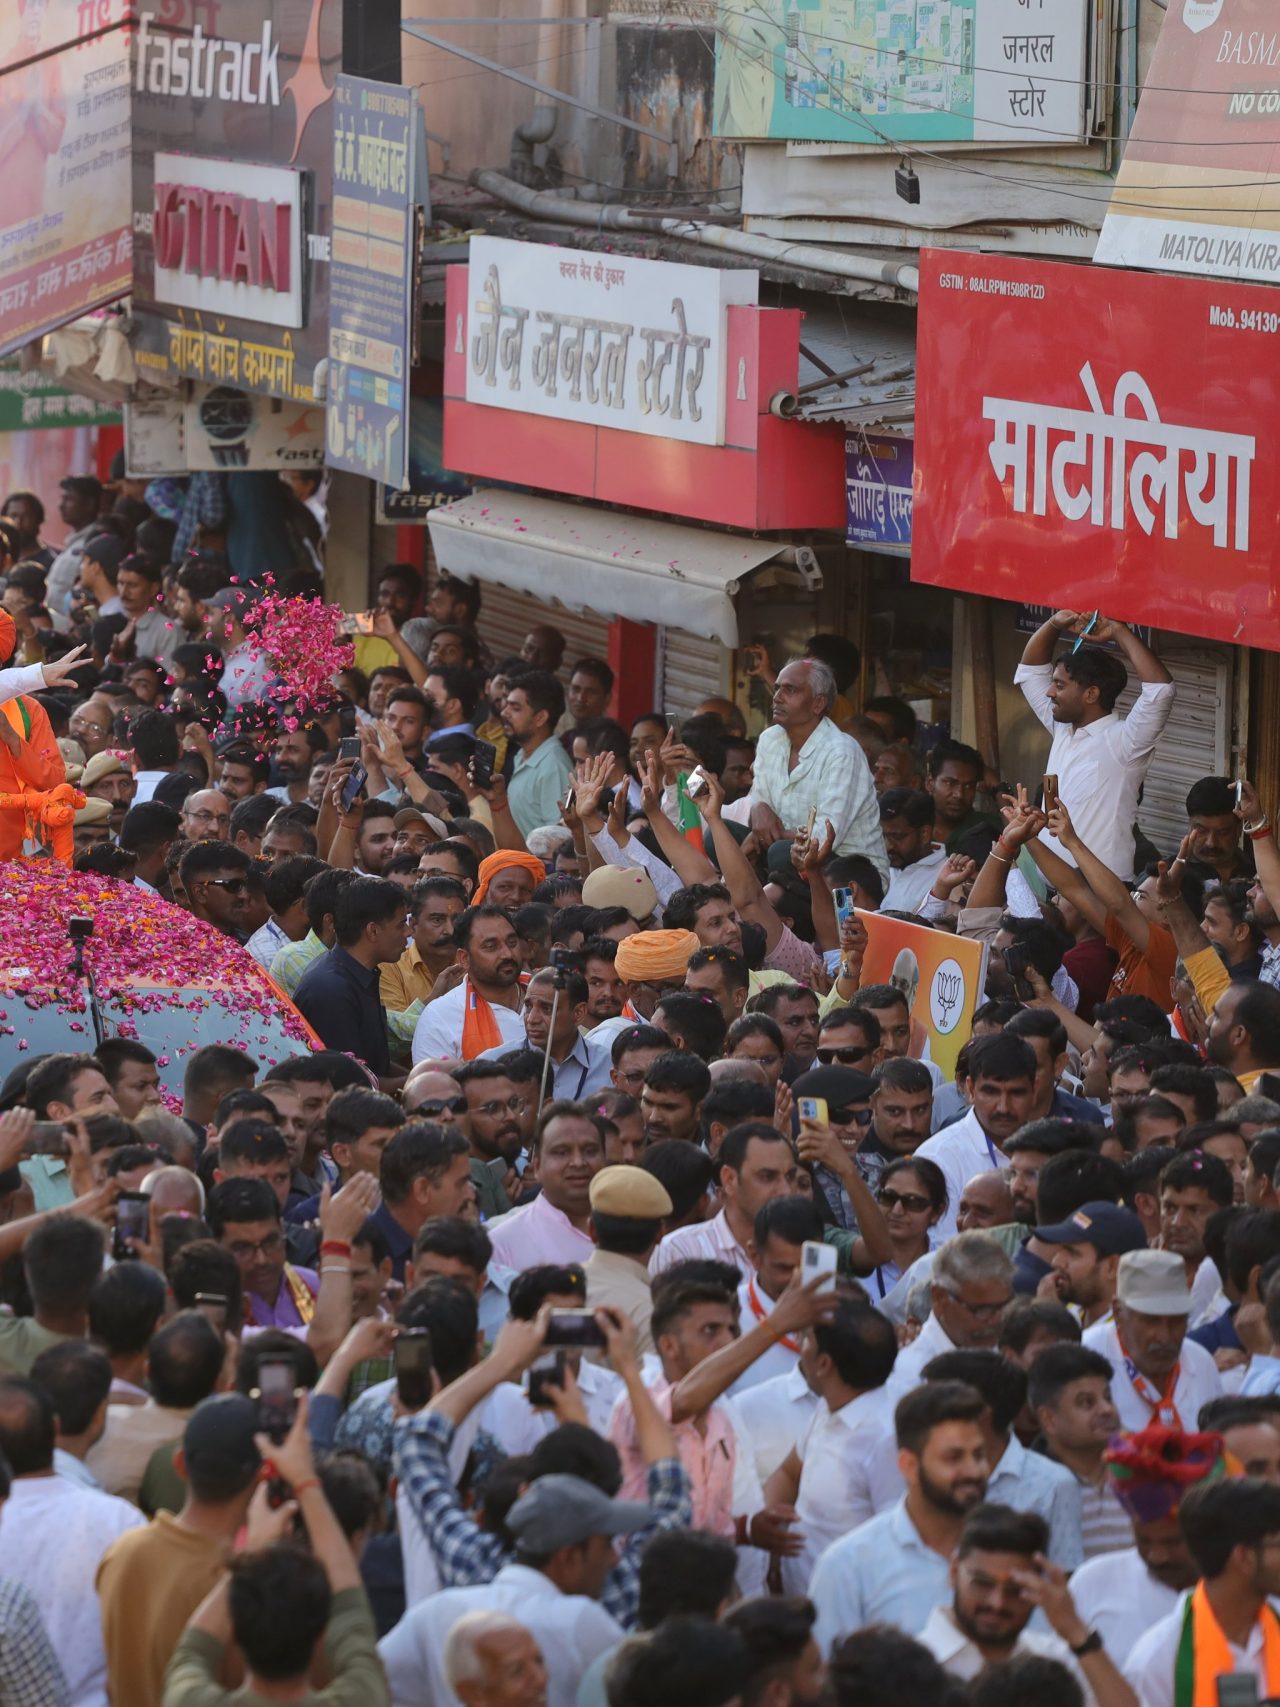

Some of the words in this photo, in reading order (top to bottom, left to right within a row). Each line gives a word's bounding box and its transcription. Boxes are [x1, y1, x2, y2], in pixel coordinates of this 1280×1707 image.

[135, 11, 280, 106] fastrack
[1002, 35, 1056, 63] जनरल
[1007, 77, 1047, 117] स्टोर
[1229, 91, 1255, 115] NO
[176, 190, 291, 293] TITAN
[307, 234, 331, 261] TIME
[1159, 233, 1243, 267] MATOLIYA
[939, 273, 963, 290] GSTIN
[241, 331, 295, 394] कम्पनी
[471, 263, 530, 392] जैन
[532, 310, 634, 410] जनरल
[637, 297, 711, 422] स्टोर
[982, 360, 1256, 552] माटोलिया
